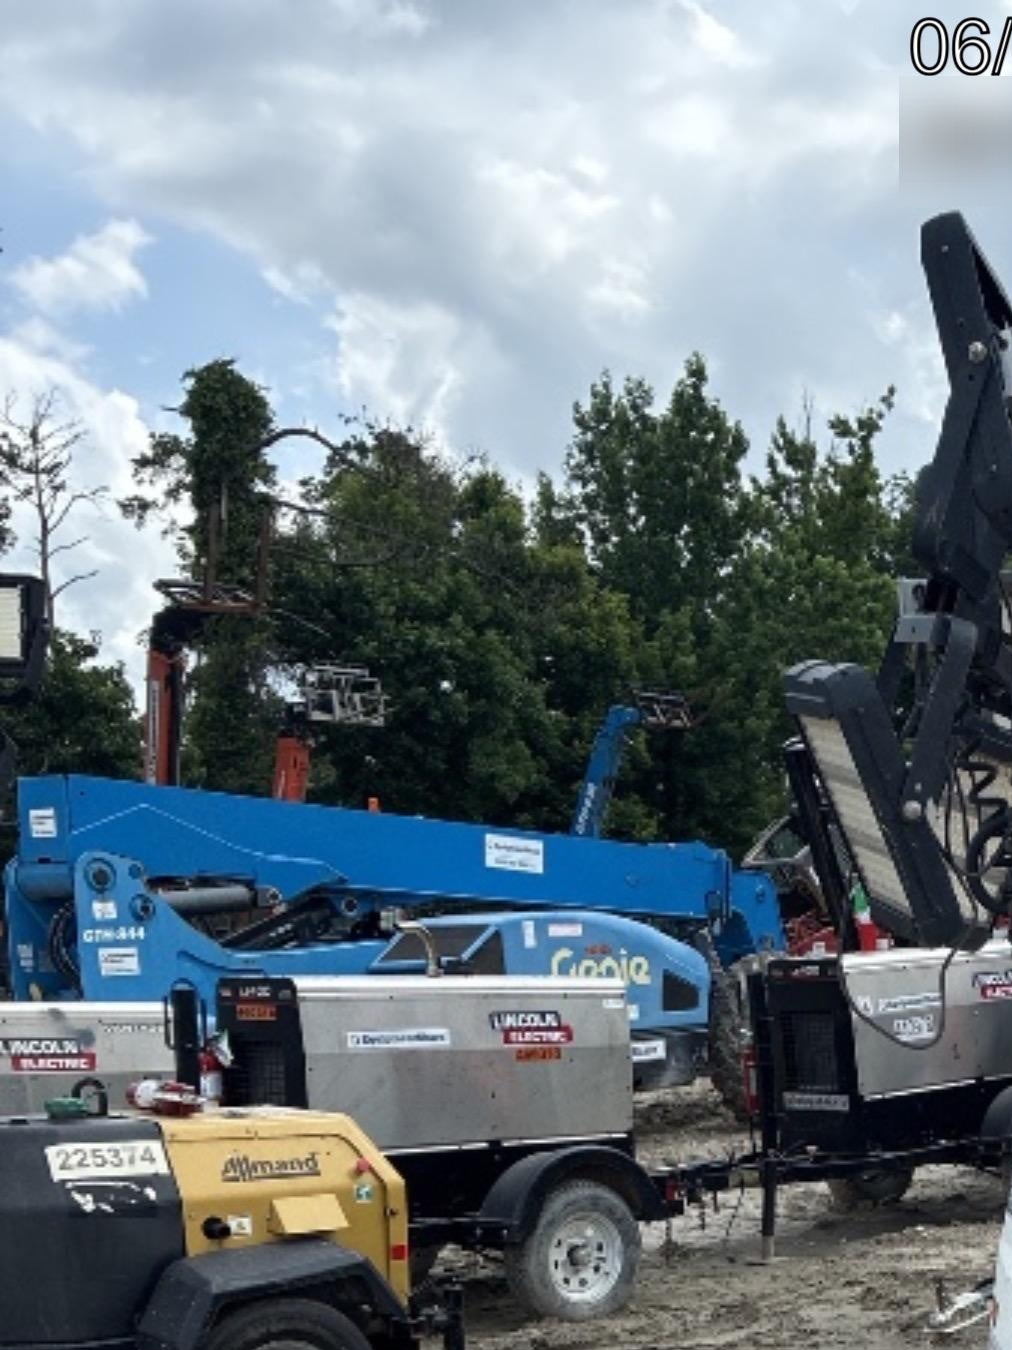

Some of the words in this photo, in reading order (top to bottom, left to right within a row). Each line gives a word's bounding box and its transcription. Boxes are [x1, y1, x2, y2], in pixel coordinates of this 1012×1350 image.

[494, 1013, 559, 1028] LINCOLN
[56, 1146, 156, 1170] 225374
[223, 1152, 320, 1181] Allmand
